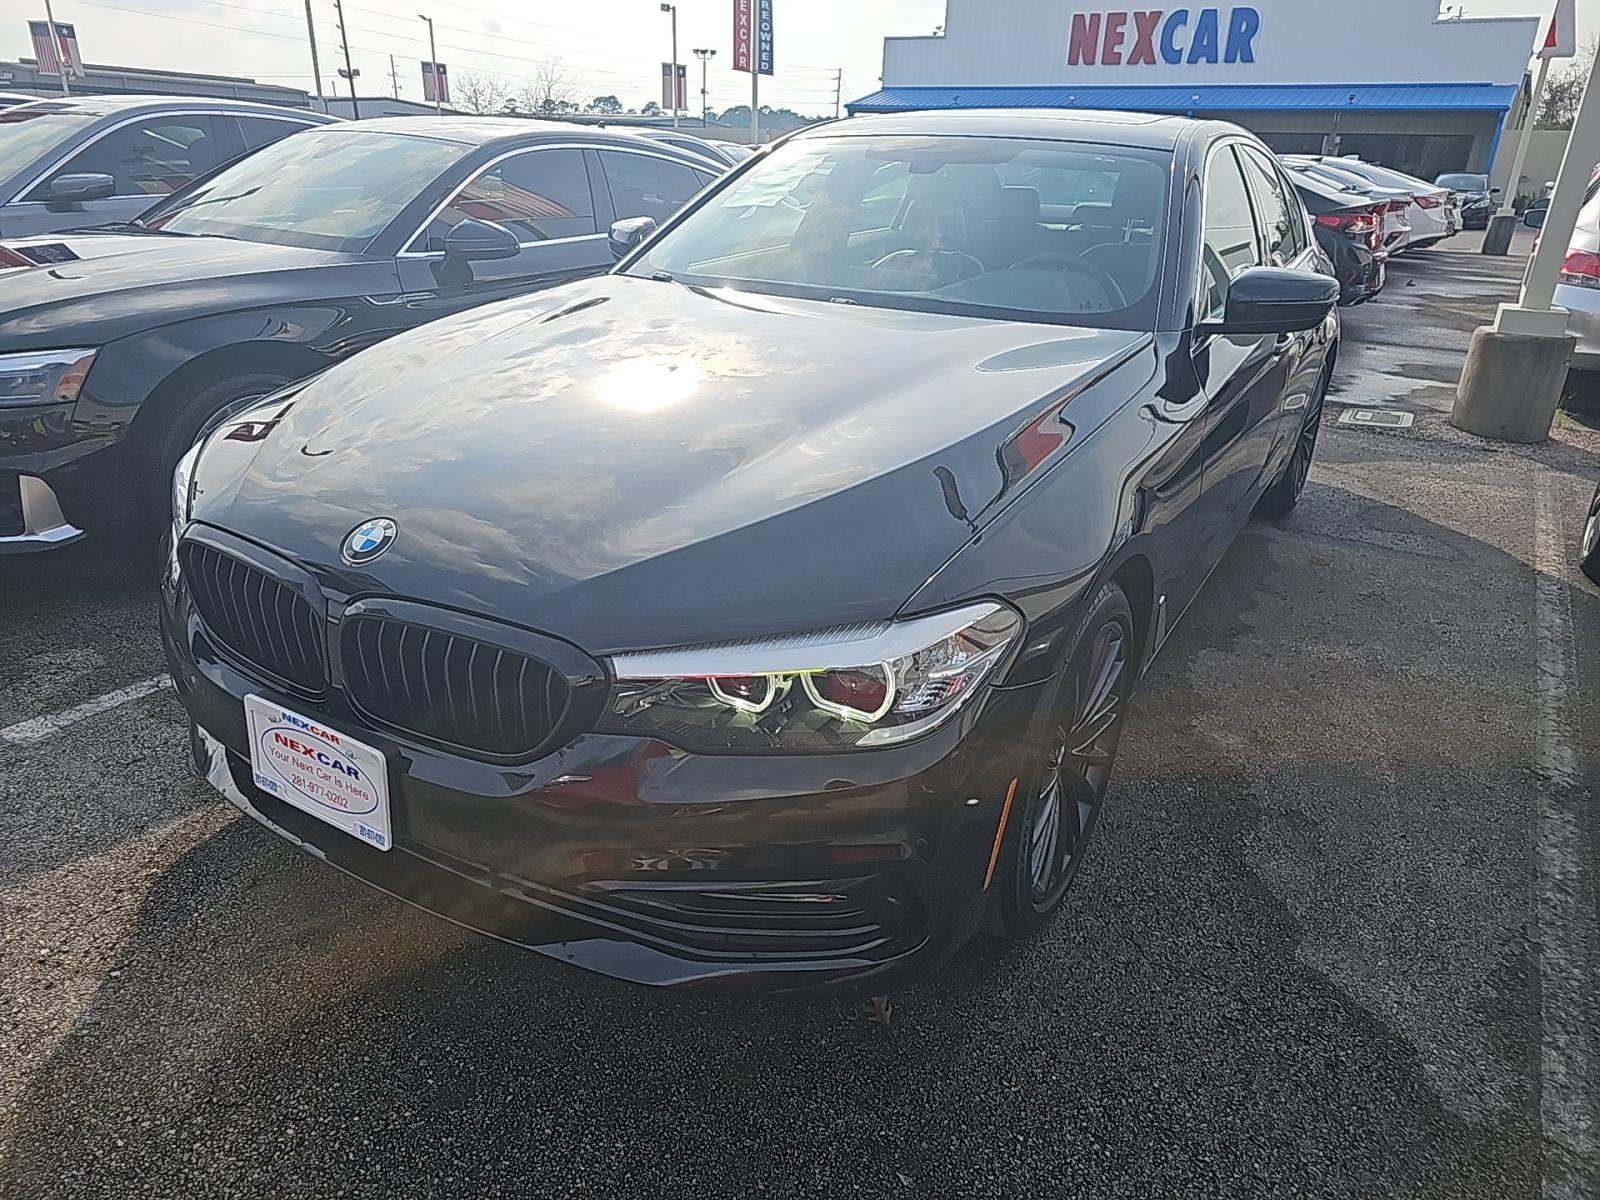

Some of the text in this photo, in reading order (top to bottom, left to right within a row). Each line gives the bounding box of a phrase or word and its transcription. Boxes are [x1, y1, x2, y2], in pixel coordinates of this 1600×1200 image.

[1067, 7, 1260, 65] NEXCAR
[282, 712, 341, 745] NEXCAR
[268, 745, 369, 801] Your Next Car Is Here
[274, 732, 360, 781] NEXCAR
